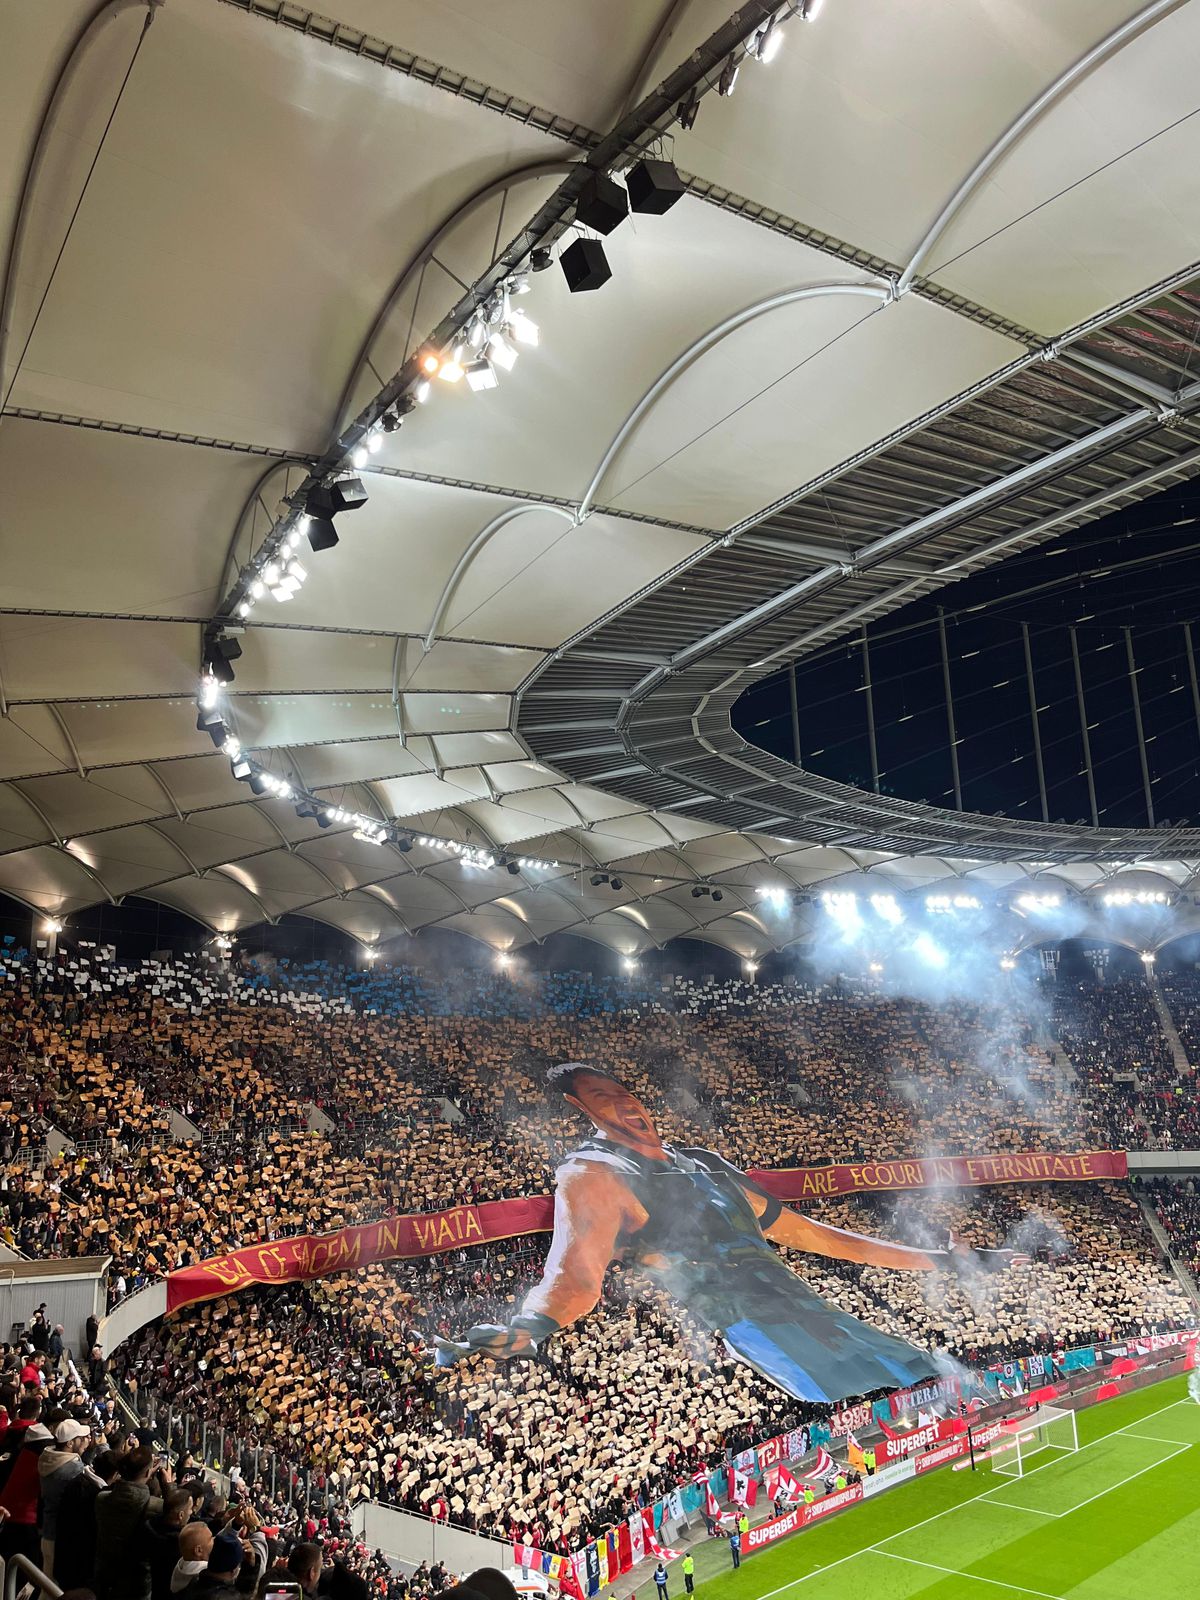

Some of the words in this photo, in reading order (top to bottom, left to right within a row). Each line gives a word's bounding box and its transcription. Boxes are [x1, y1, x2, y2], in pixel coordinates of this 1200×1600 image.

[802, 1169, 839, 1195] ARE
[850, 1163, 924, 1186] ECOURI
[933, 1160, 955, 1182] IN
[966, 1155, 1094, 1181] ETERNITATE
[257, 1247, 289, 1279] CE
[291, 1233, 361, 1273] FACEM
[375, 1220, 400, 1254] IN
[413, 1210, 482, 1249] VIATA
[886, 1422, 940, 1457] SUPERBET
[748, 1511, 798, 1546] SUPERBET
